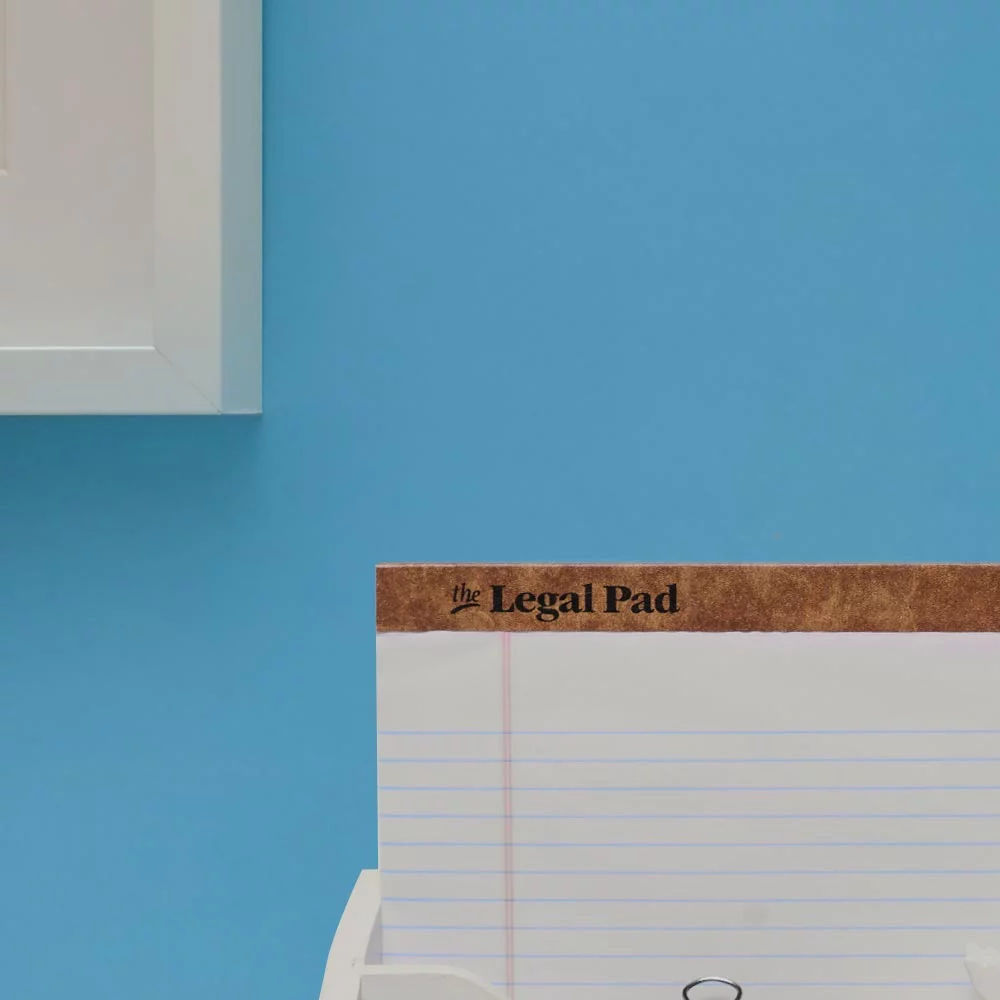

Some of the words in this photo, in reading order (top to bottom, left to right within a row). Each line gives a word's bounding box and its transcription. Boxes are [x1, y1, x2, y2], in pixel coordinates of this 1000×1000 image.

[452, 583, 481, 602] the
[490, 583, 595, 622] Legal
[603, 583, 680, 614] Pad
